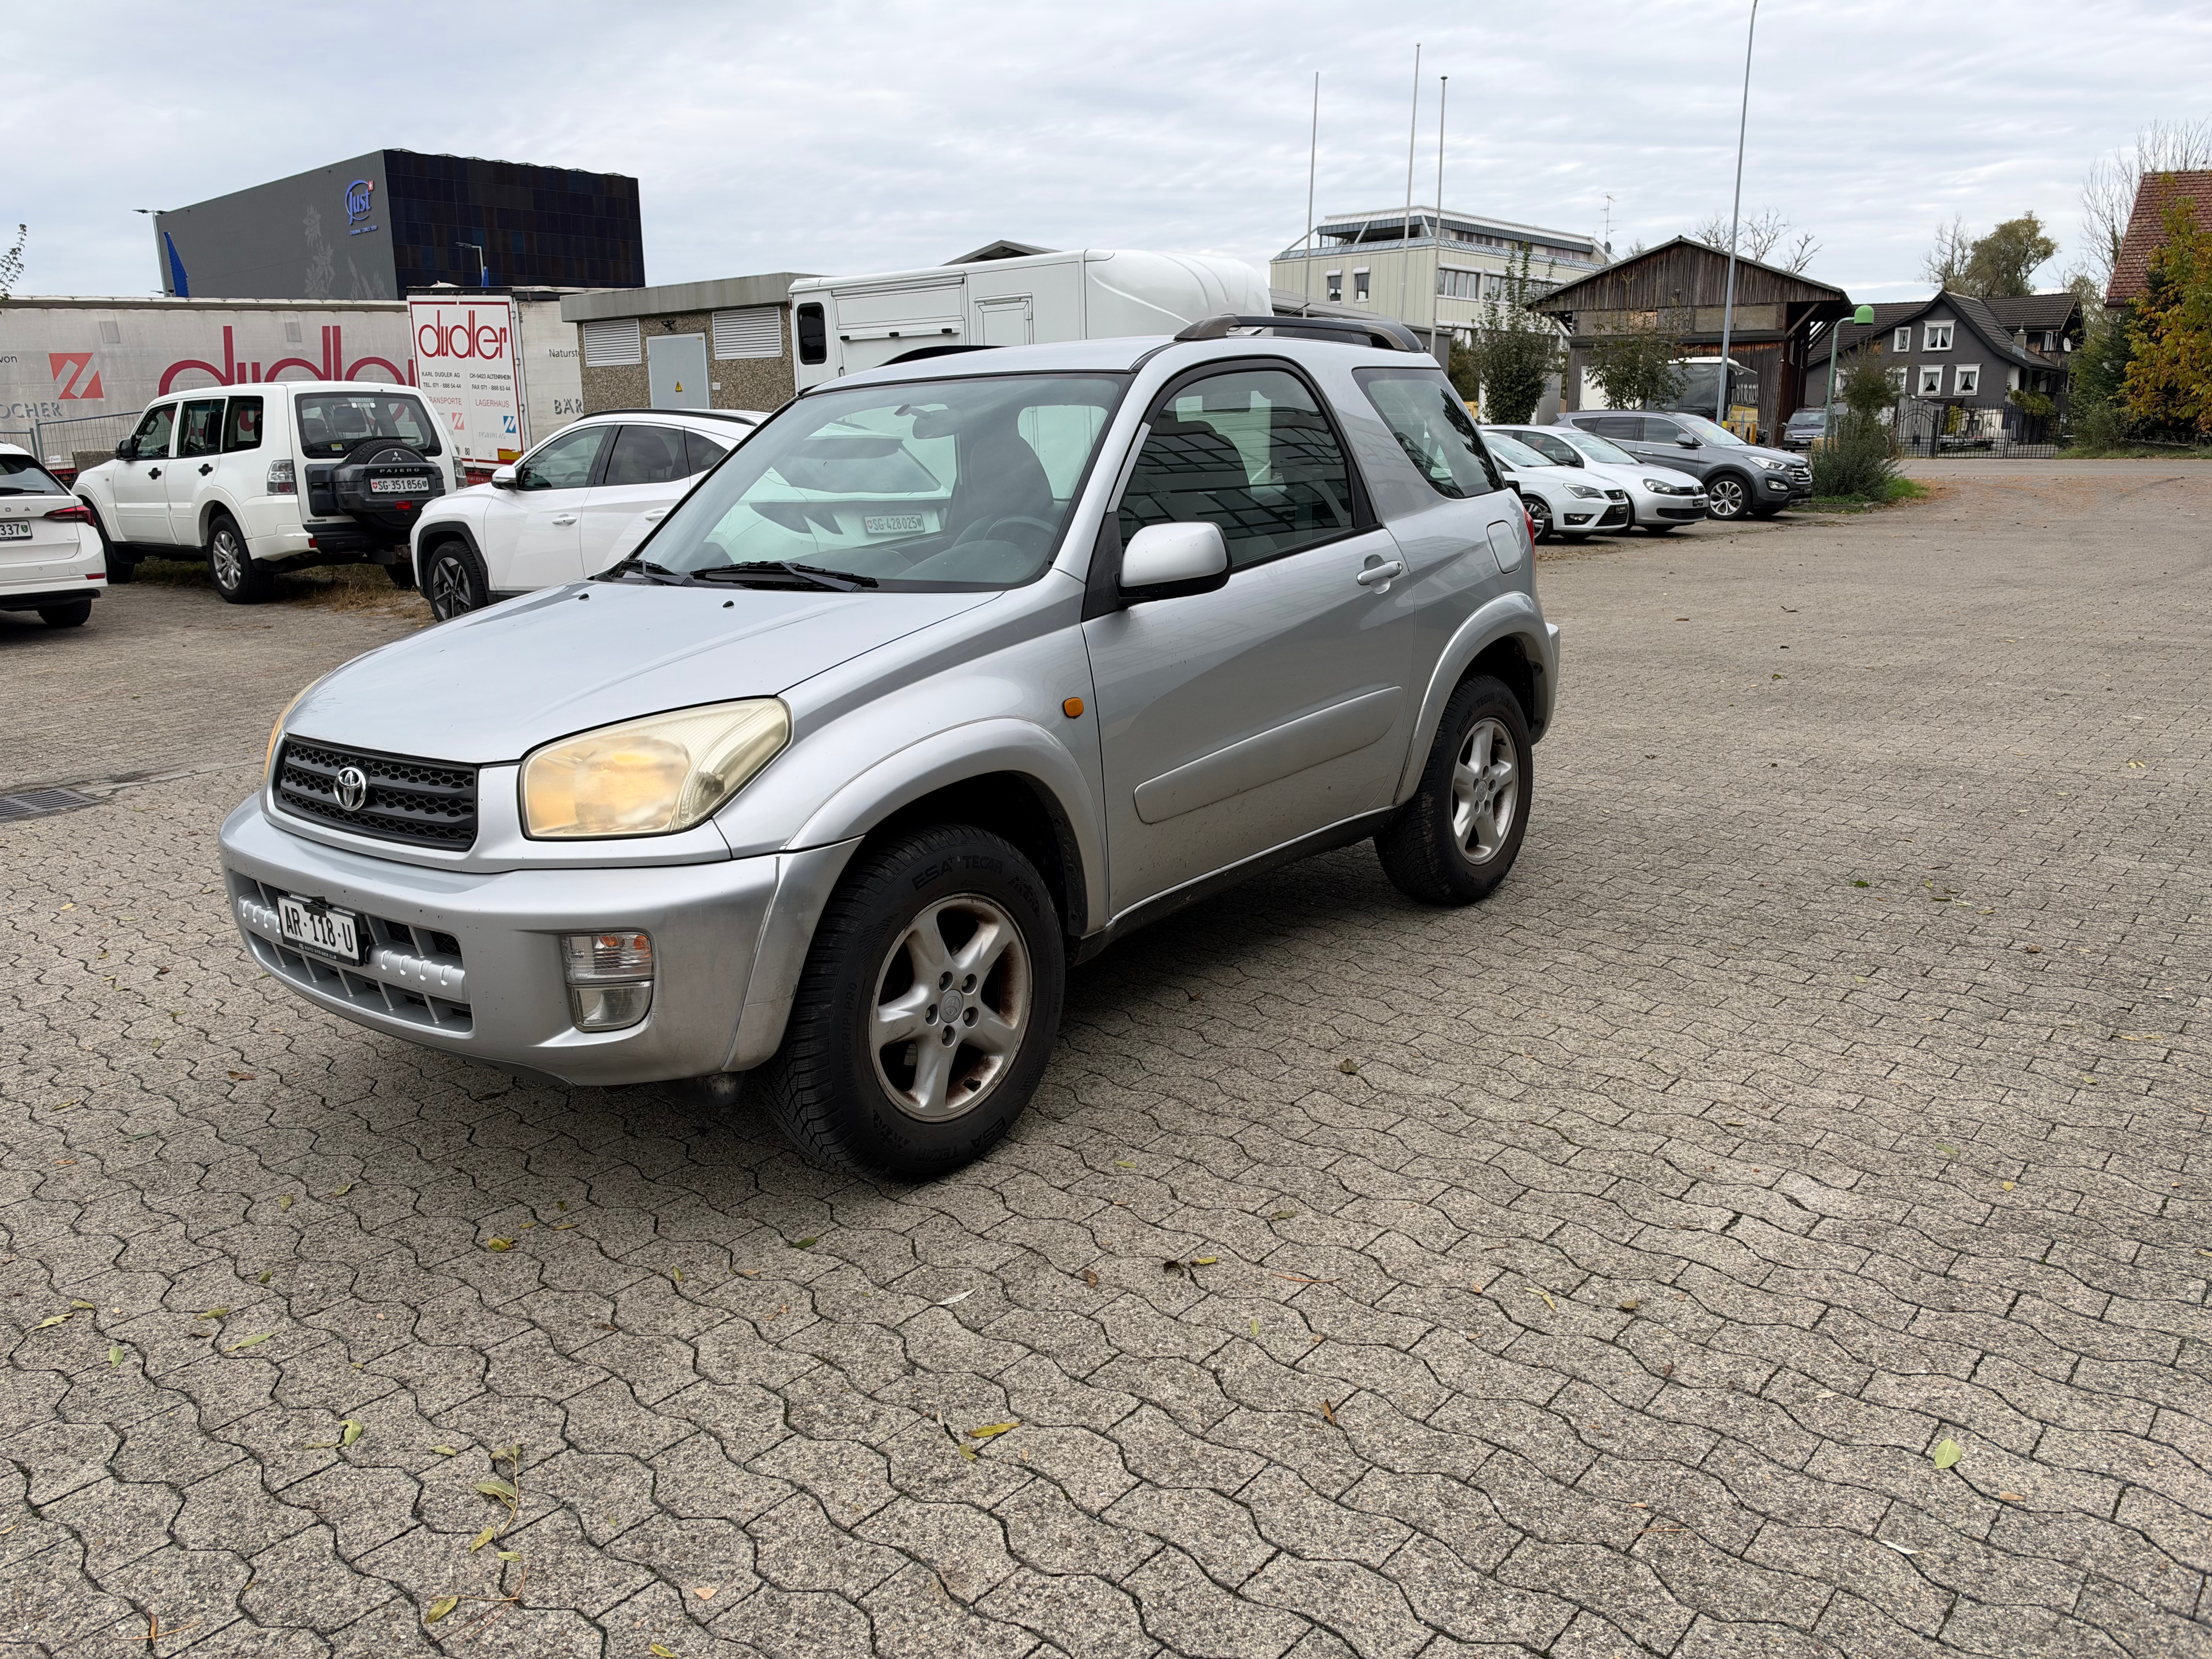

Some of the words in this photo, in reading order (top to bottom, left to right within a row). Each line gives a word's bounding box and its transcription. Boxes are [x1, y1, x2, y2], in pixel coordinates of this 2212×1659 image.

[349, 188, 371, 225] Just
[418, 310, 507, 360] dudler
[475, 399, 510, 408] LAGERHAUS
[465, 447, 470, 456] 80
[962, 855, 1003, 874] TECAR
[843, 982, 857, 1011] PRO
